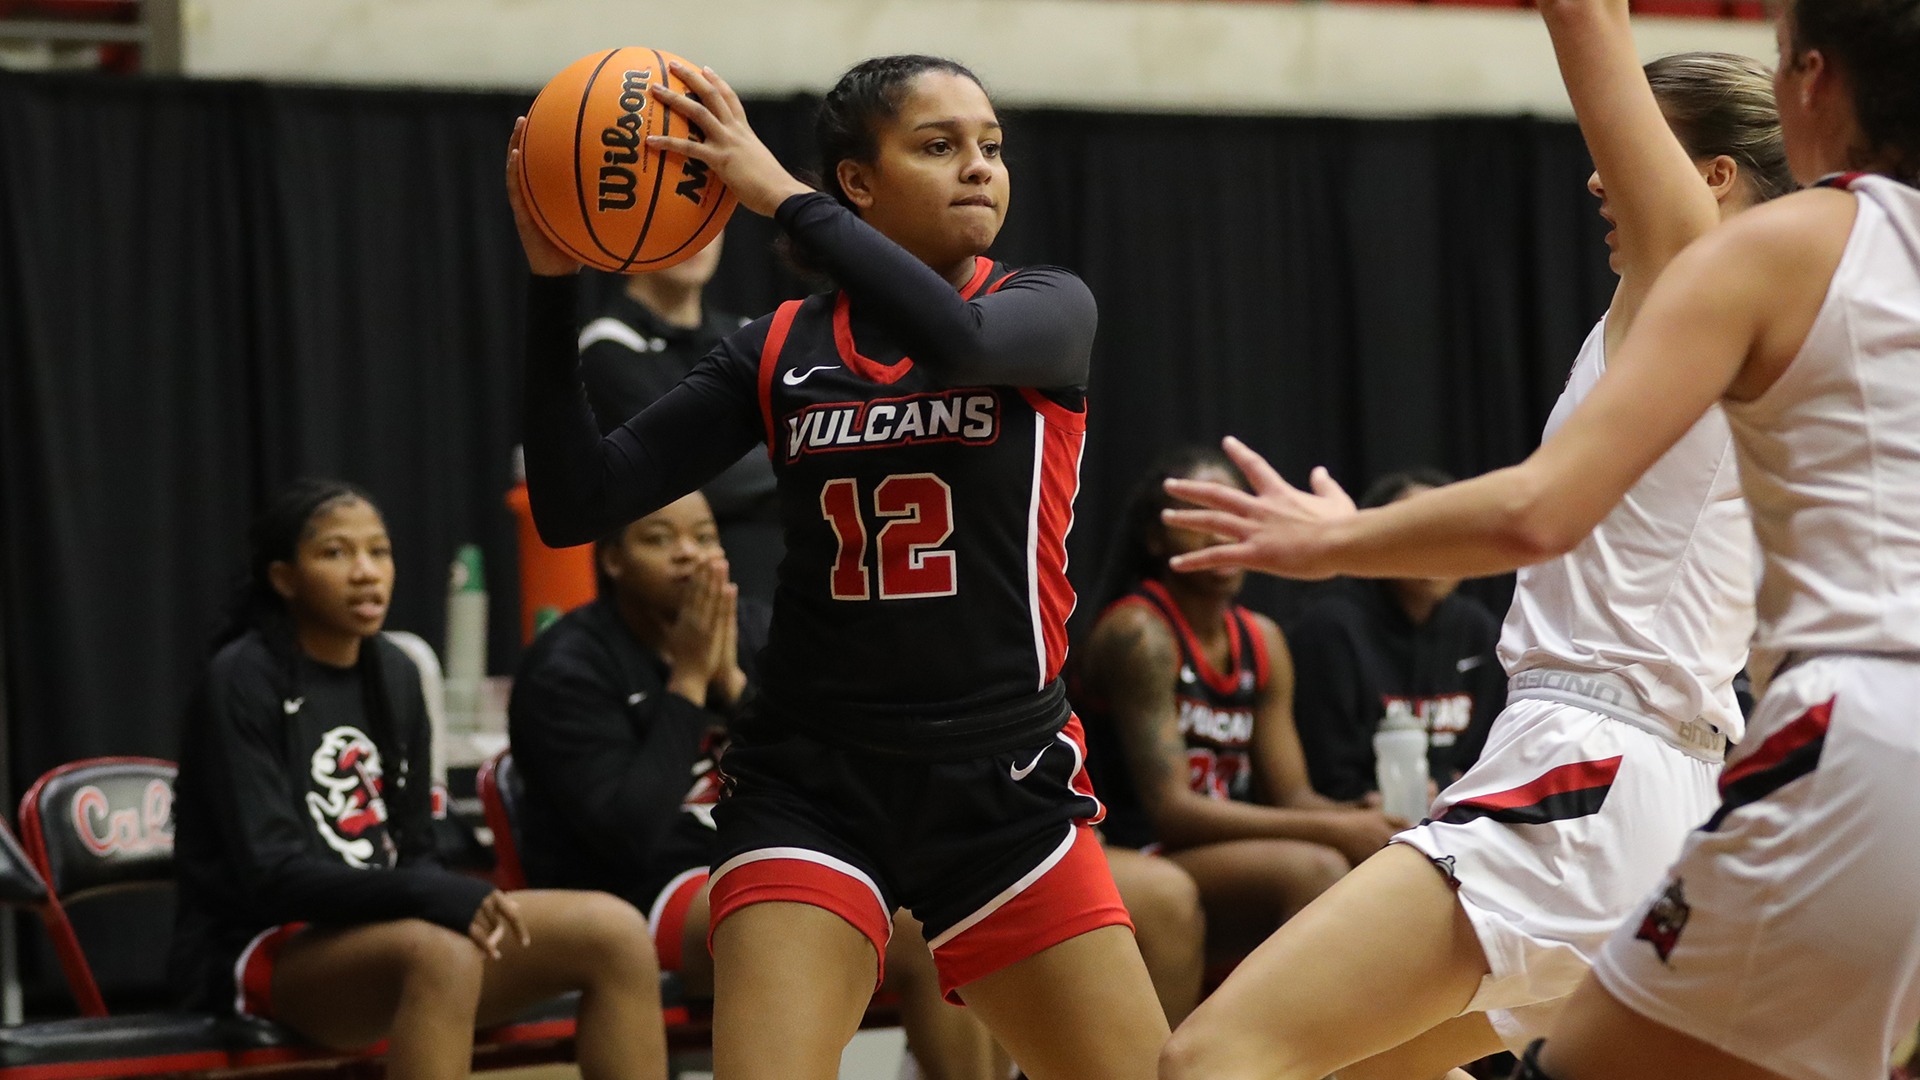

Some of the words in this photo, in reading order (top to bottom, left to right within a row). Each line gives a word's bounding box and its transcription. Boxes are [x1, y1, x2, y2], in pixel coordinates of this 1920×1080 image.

[598, 69, 650, 212] Wilson
[786, 394, 996, 459] VULCANS
[820, 472, 957, 600] 12
